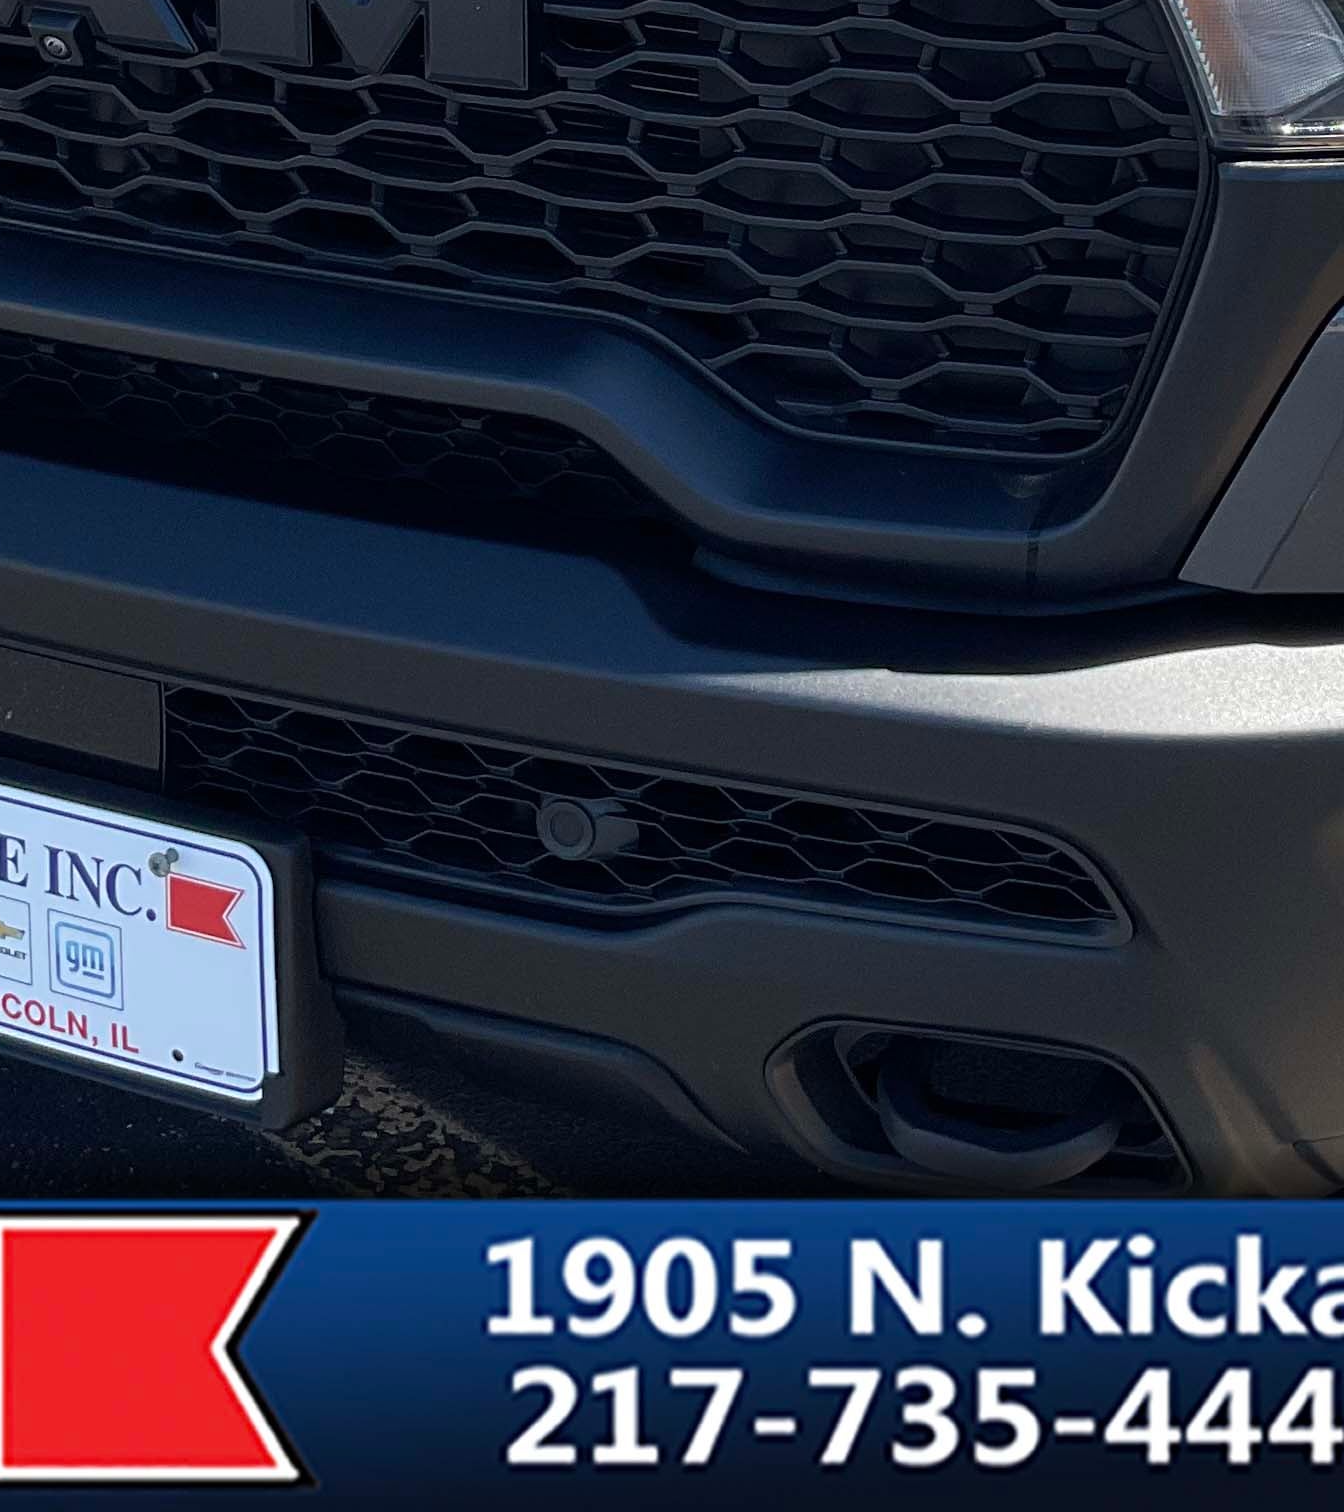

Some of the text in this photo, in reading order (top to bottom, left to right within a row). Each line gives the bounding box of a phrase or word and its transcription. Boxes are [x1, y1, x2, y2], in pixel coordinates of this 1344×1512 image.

[43, 844, 157, 922] INC.
[65, 940, 105, 973] gm
[111, 1024, 140, 1054] IL
